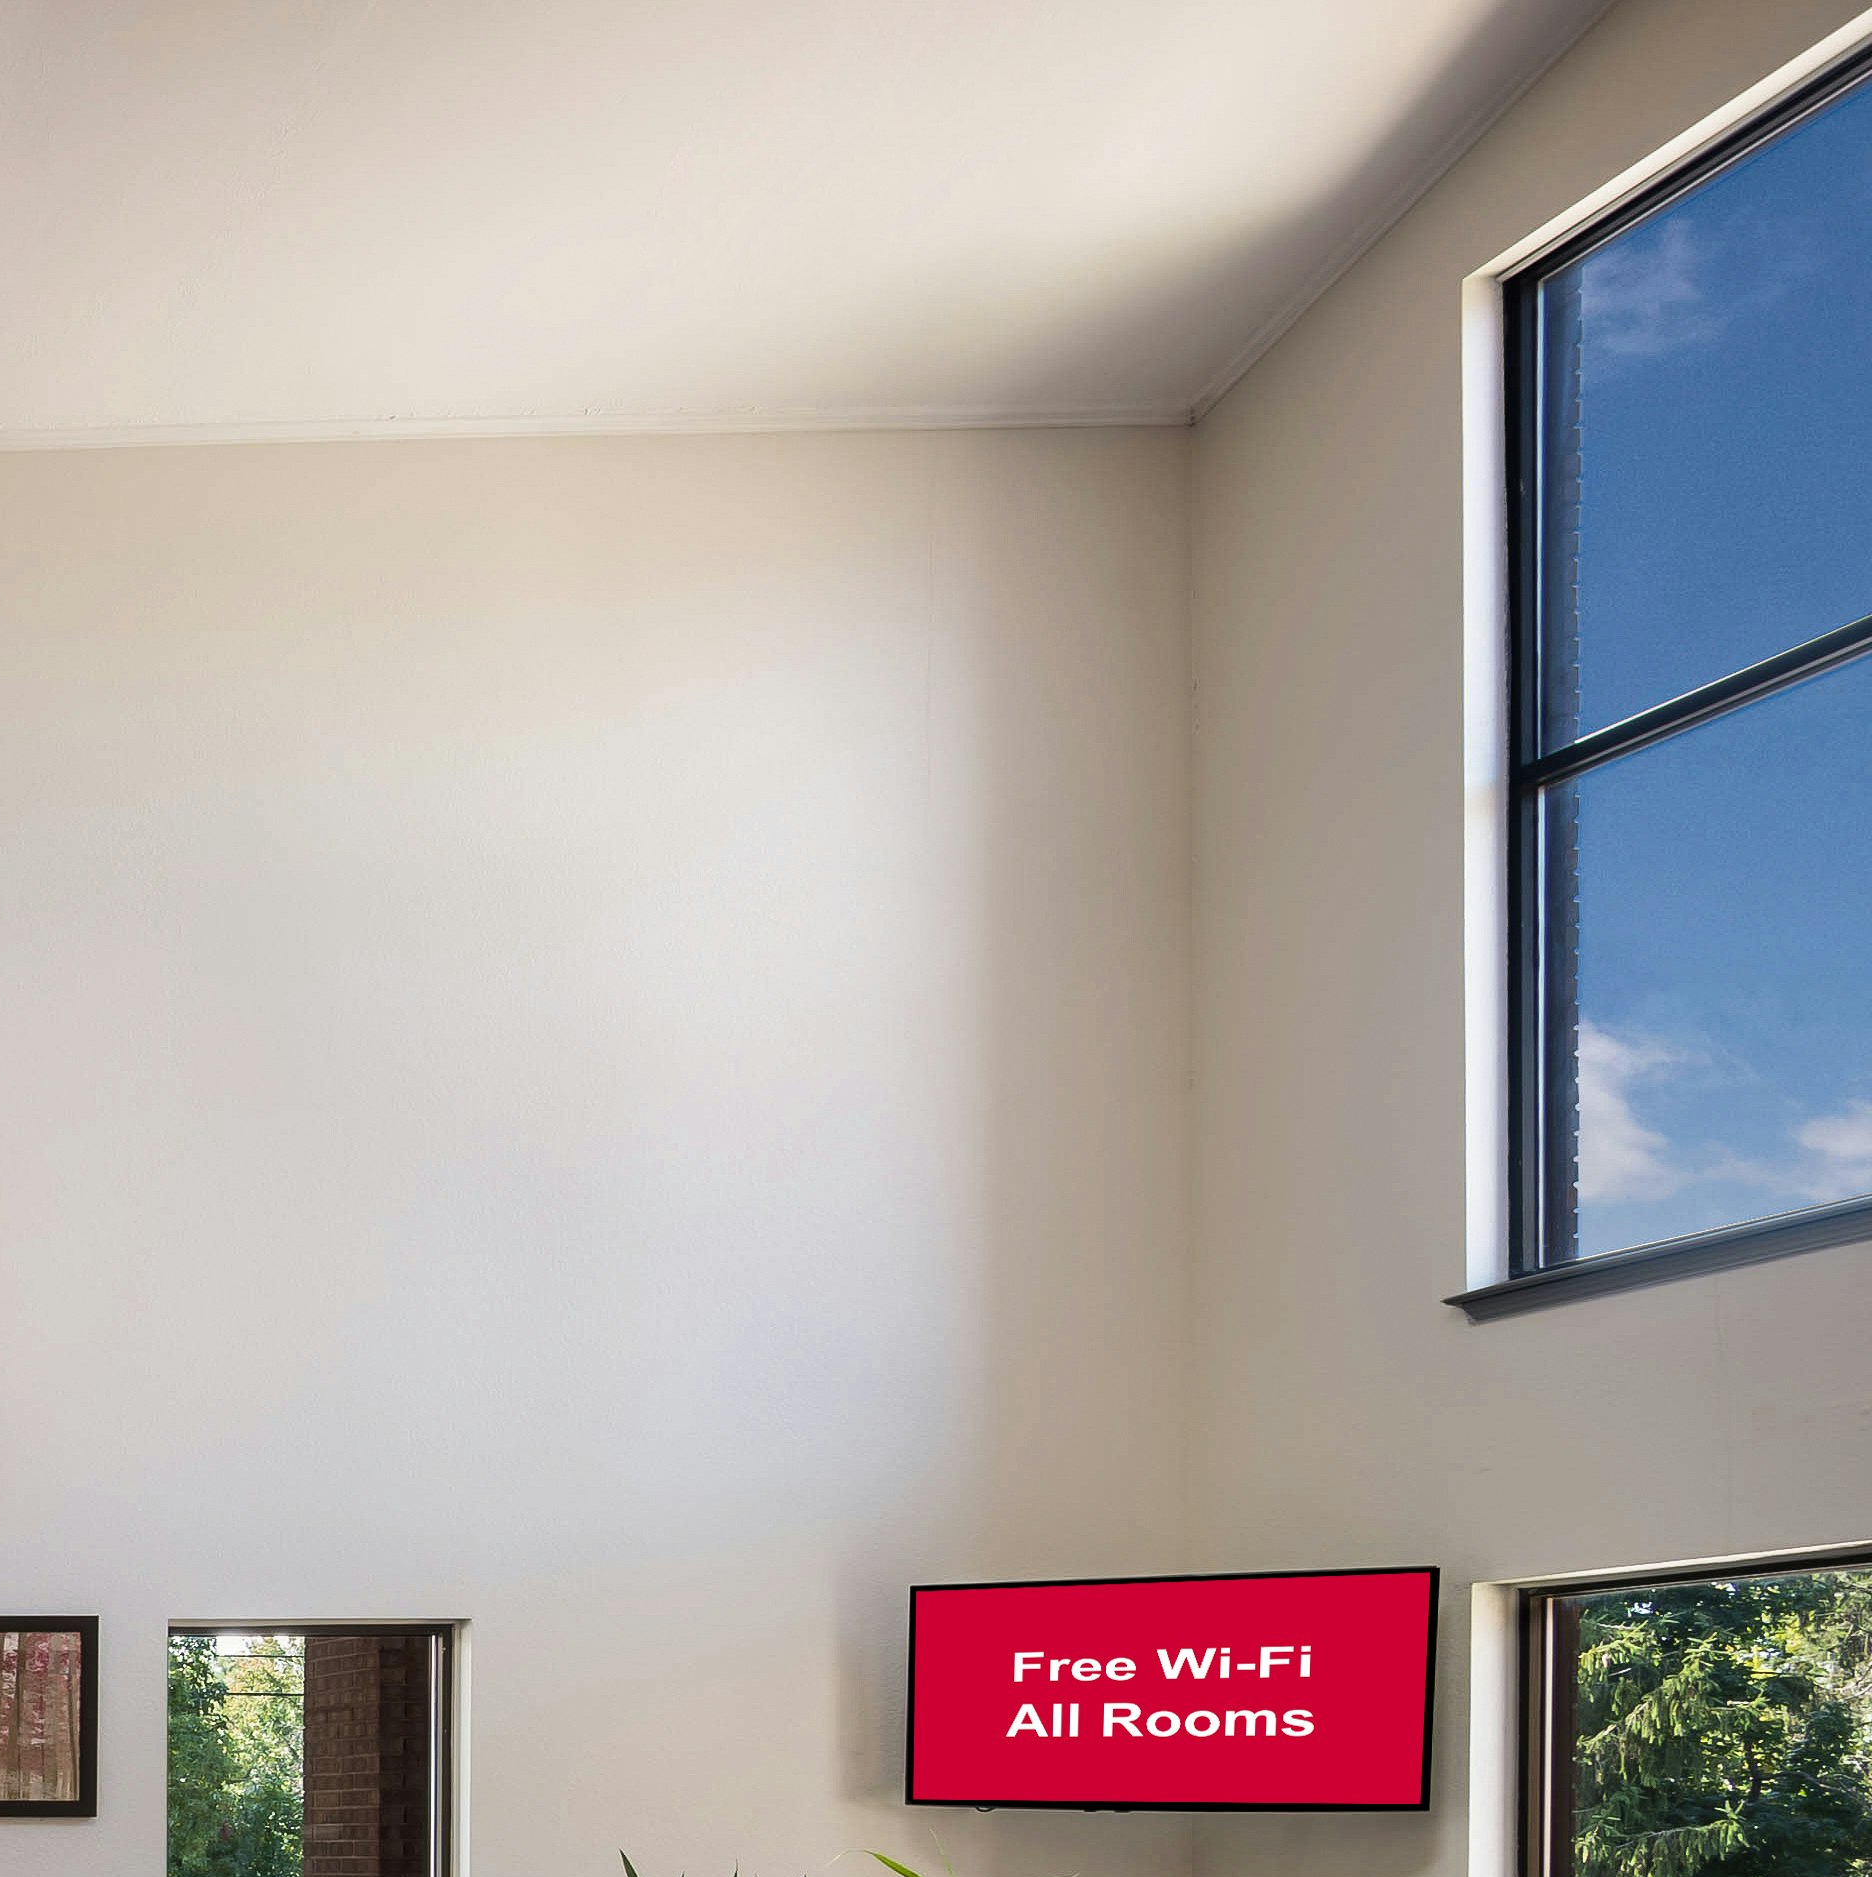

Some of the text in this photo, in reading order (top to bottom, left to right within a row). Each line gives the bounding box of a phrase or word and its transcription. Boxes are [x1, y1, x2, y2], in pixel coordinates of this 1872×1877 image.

[1013, 1645, 1312, 1683] Free Wi-Fi
[1005, 1702, 1315, 1738] All Rooms
